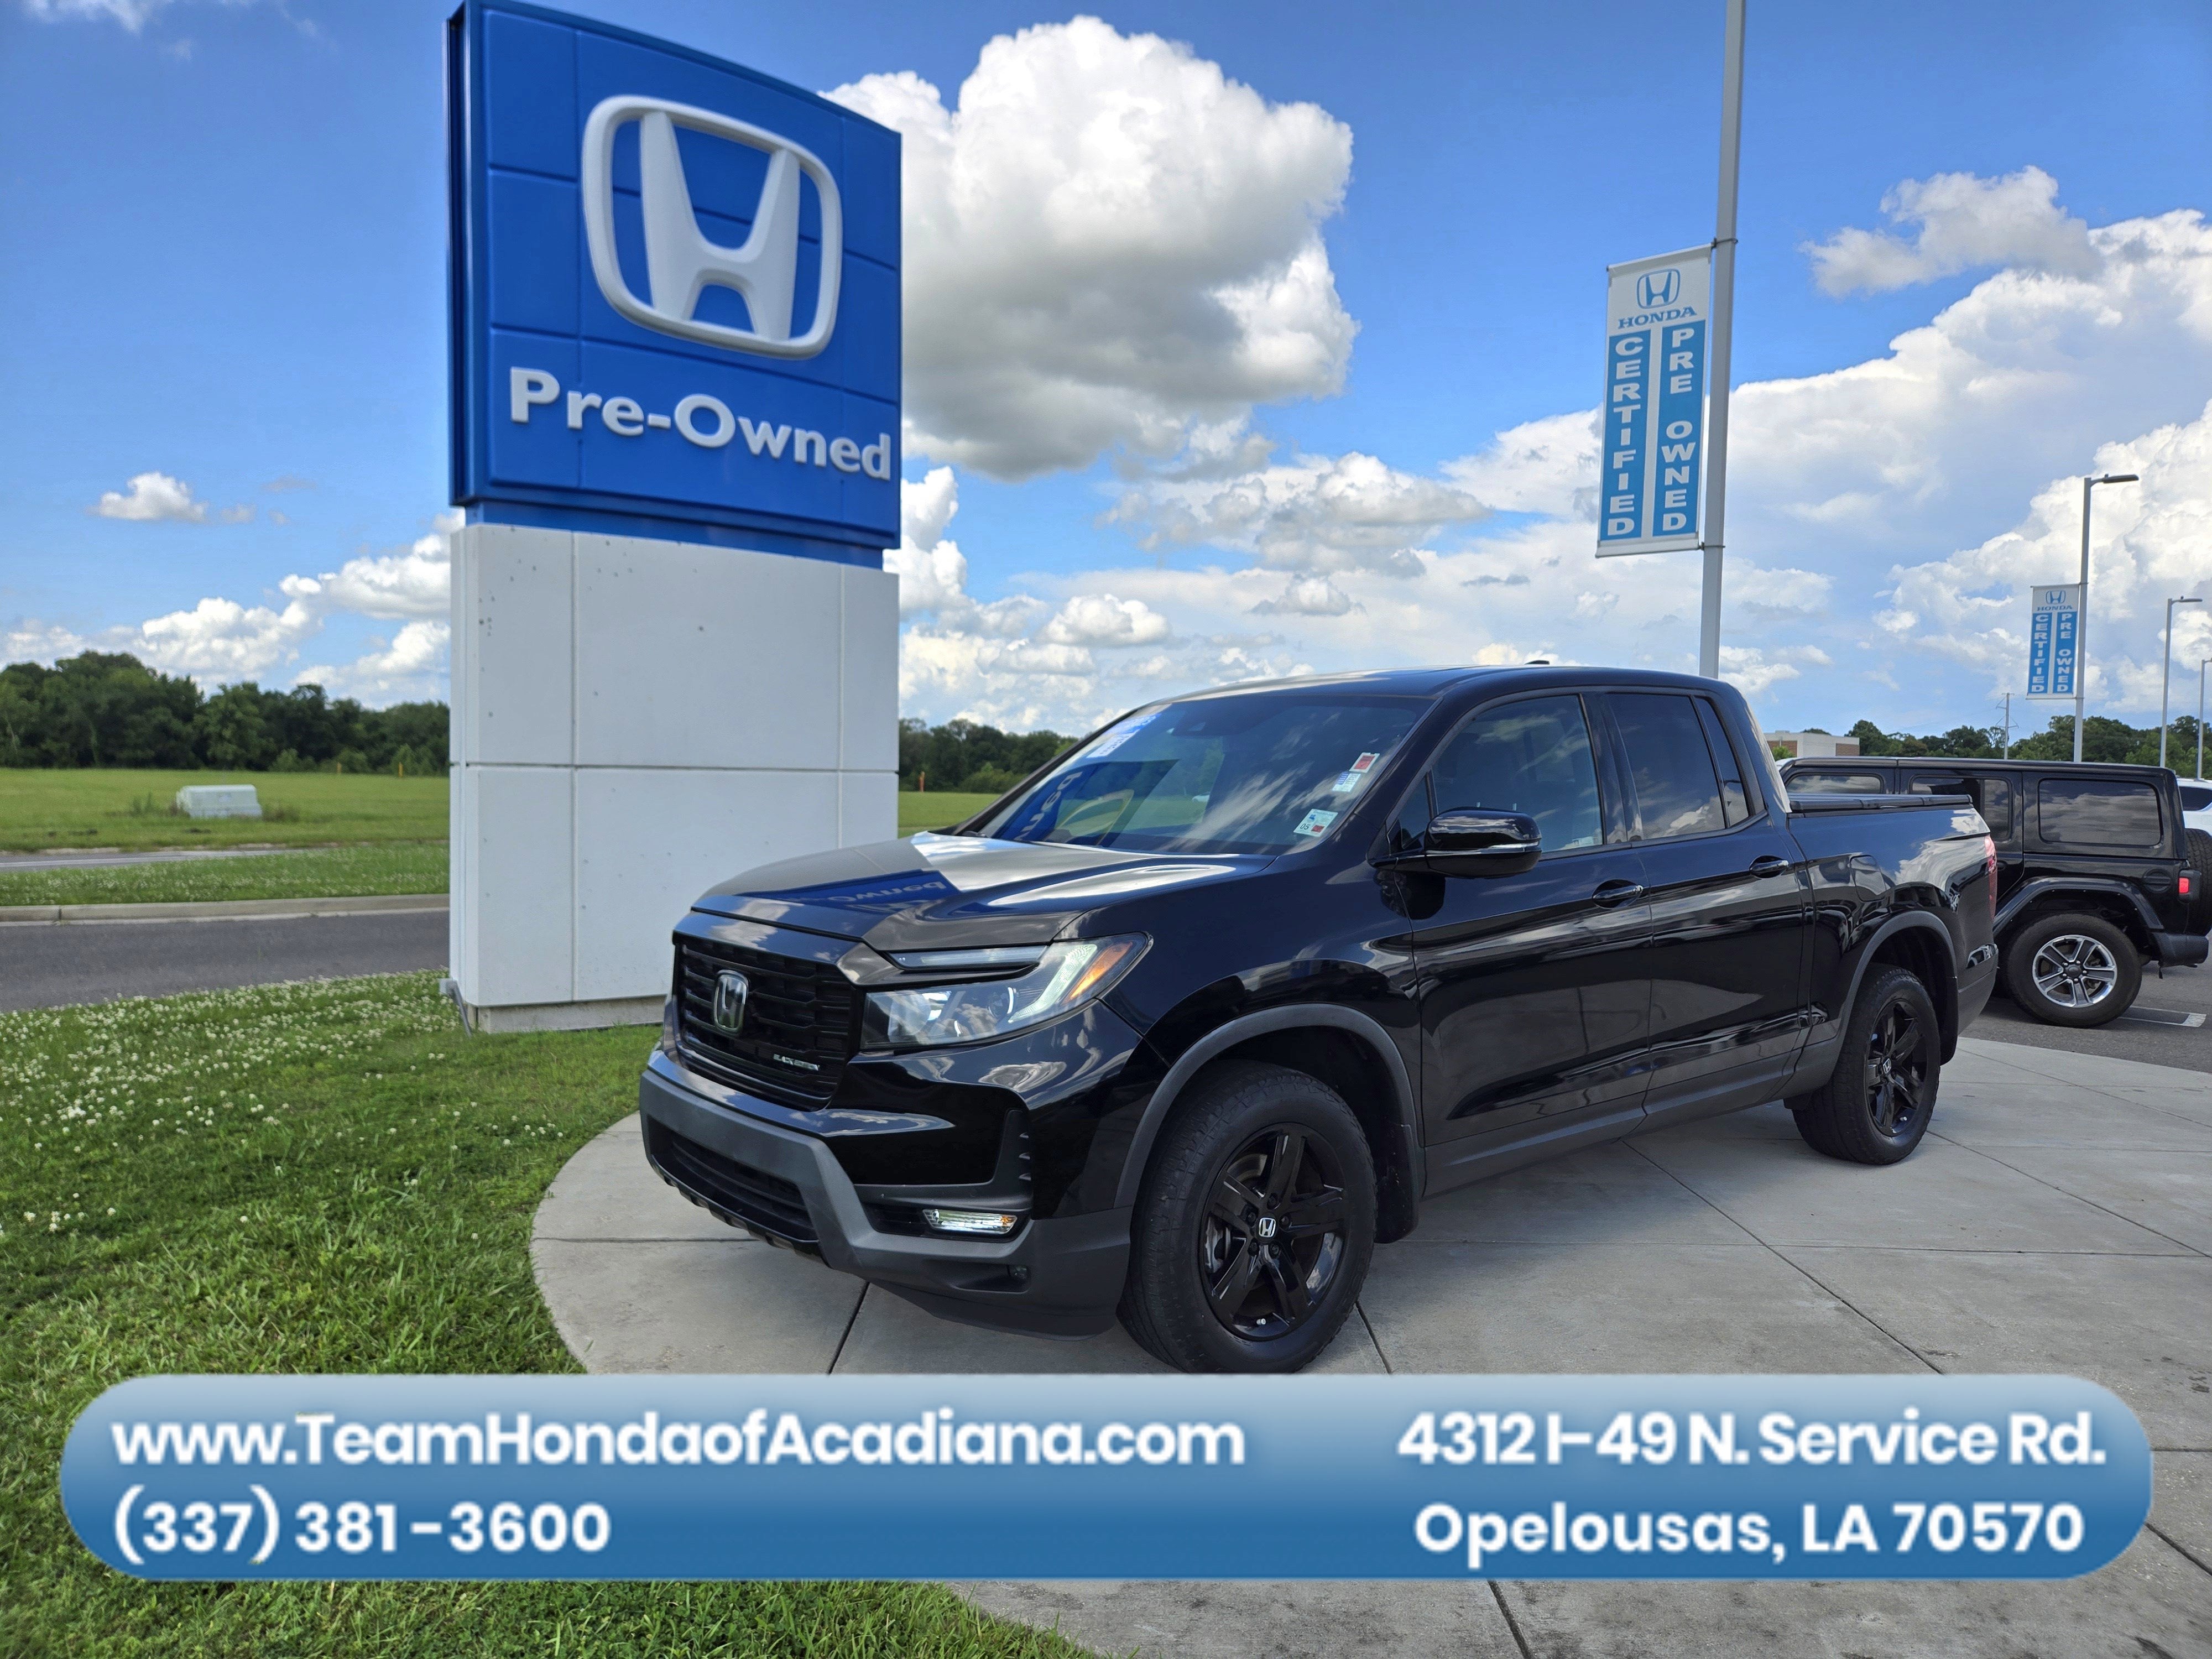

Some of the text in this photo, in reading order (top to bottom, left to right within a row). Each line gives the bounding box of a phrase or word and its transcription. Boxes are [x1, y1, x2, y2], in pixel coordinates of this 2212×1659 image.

[1618, 306, 1698, 329] HONDA
[510, 367, 891, 481] Pre-Owned
[1607, 337, 1644, 536] CERTIFIED
[1661, 328, 1696, 532] PRE OWNED
[2031, 614, 2049, 692] CERTIFIED
[2056, 613, 2073, 692] PRE OWNED
